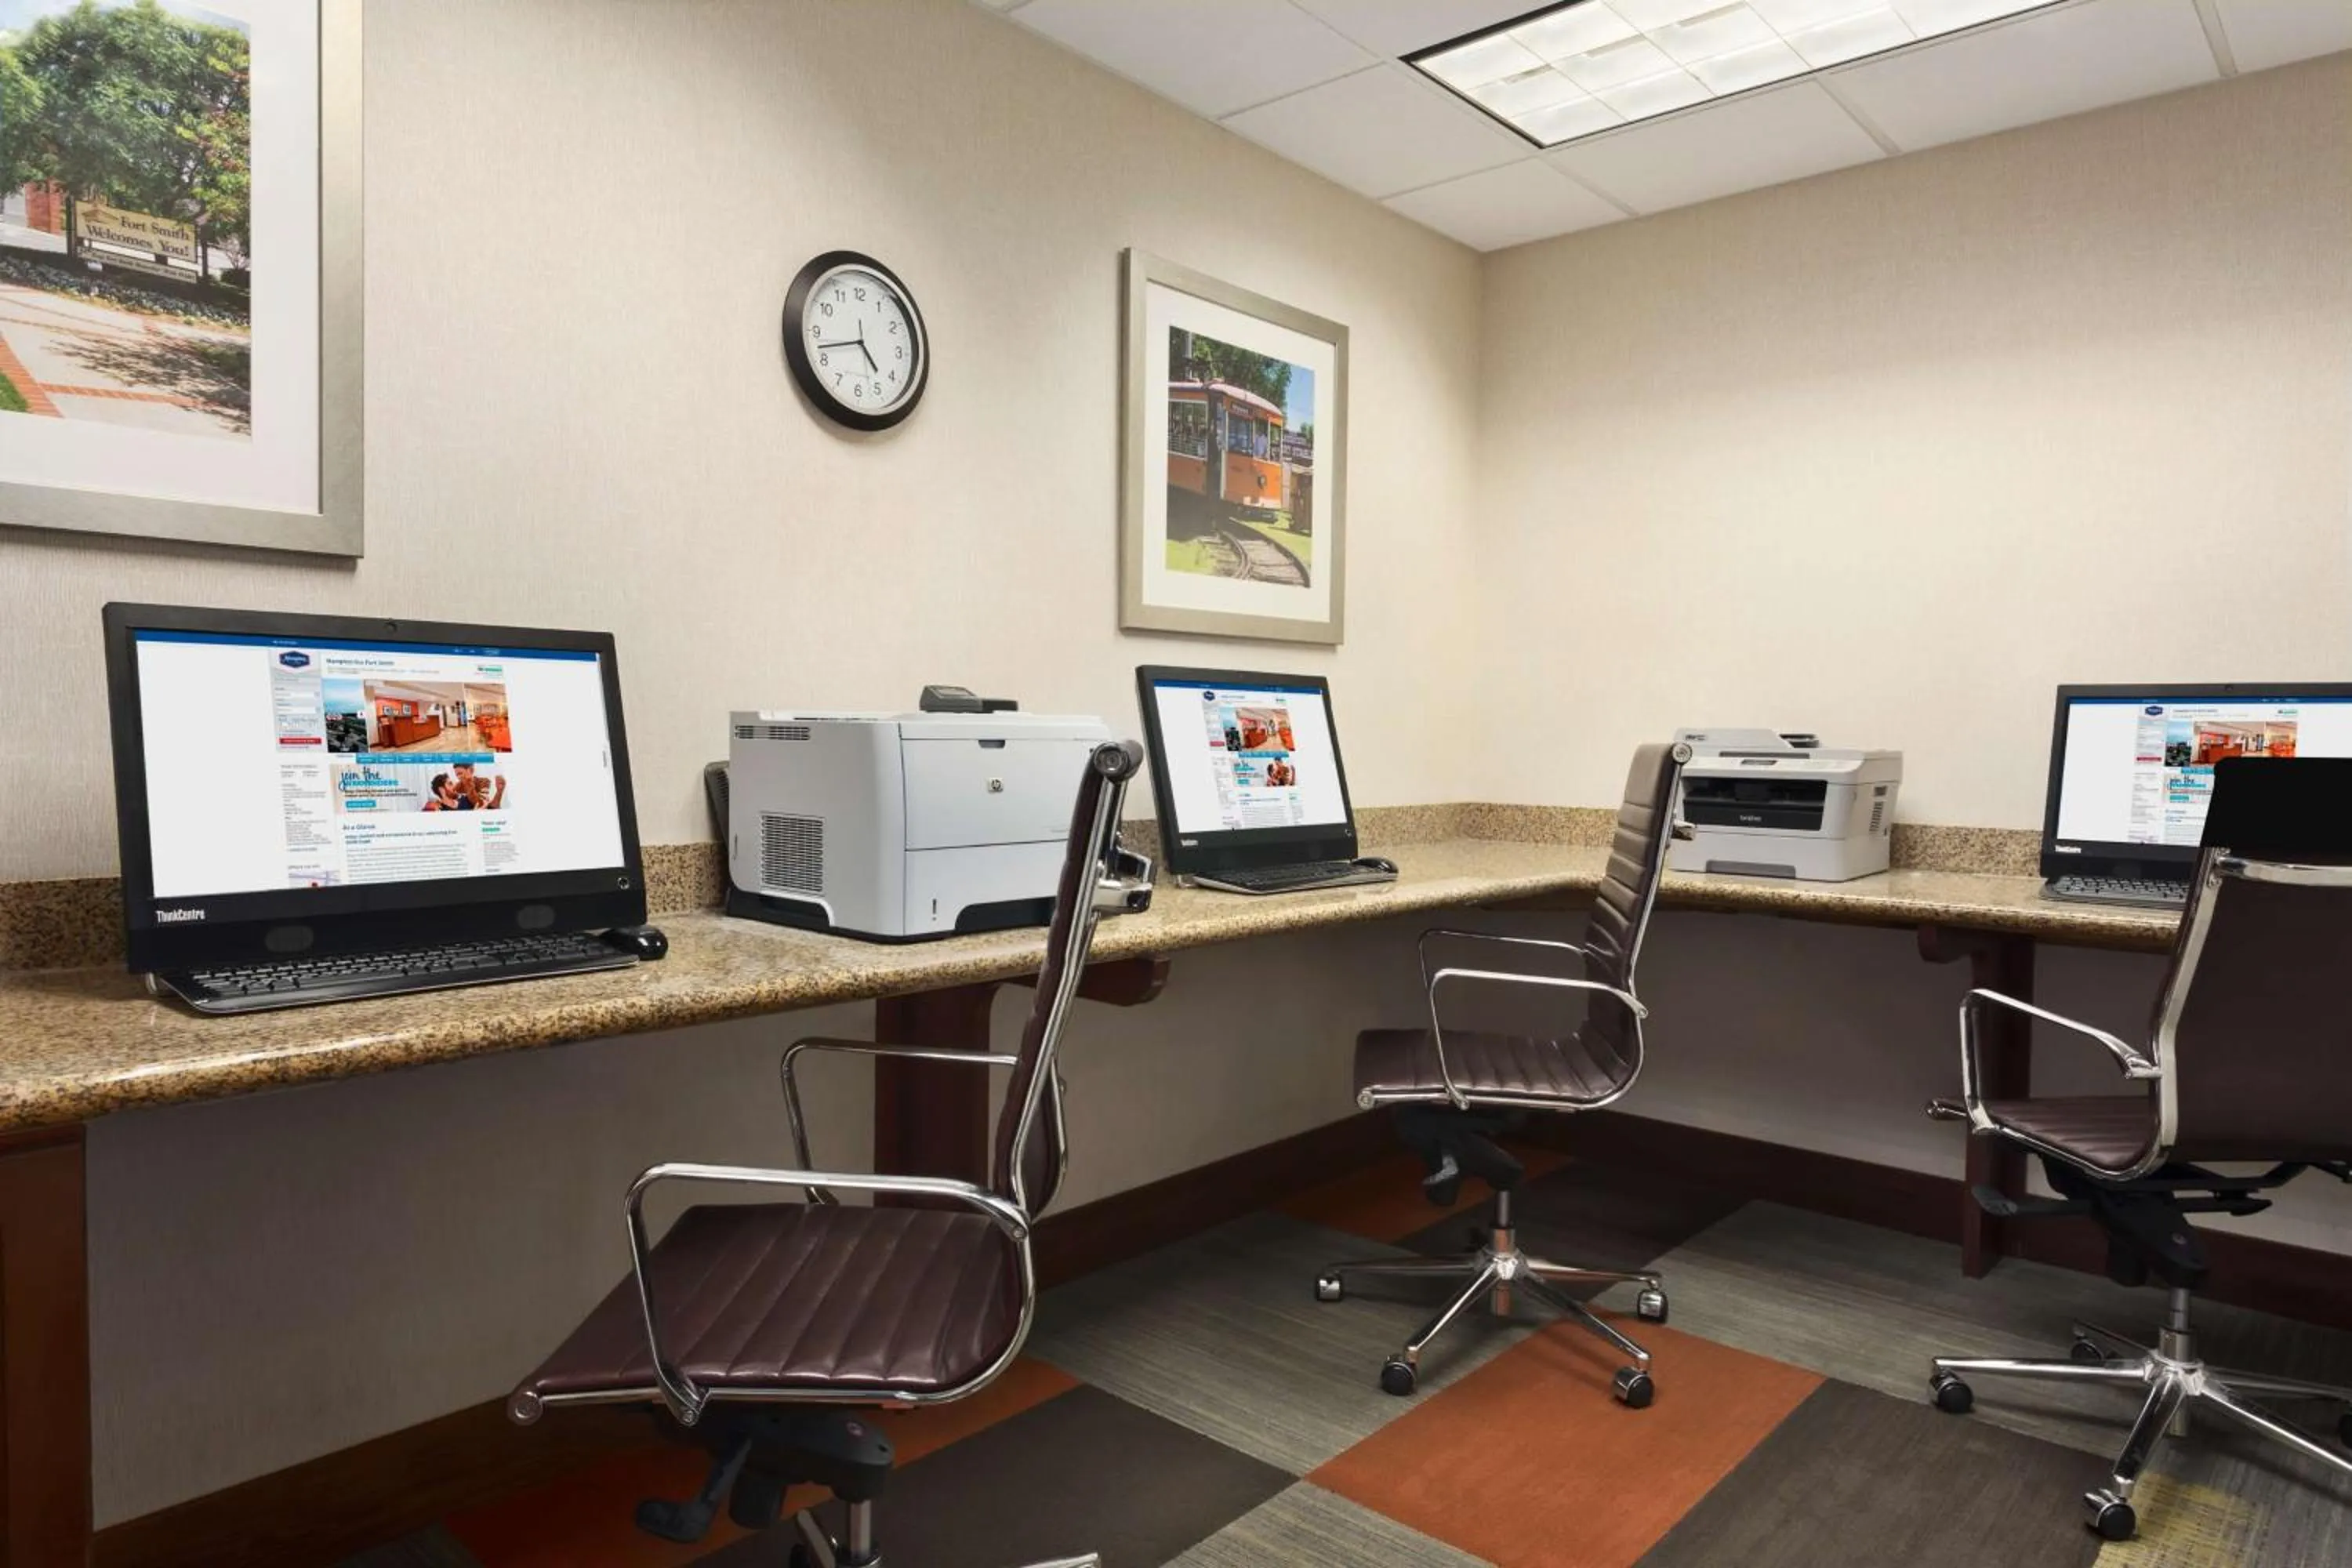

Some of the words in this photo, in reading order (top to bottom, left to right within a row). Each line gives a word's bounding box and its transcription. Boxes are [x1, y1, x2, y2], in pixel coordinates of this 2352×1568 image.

[121, 216, 147, 232] Fort
[151, 222, 190, 241] Smith
[85, 224, 154, 249] Welcomes
[158, 239, 190, 257] You!
[834, 289, 846, 303] 11
[854, 288, 866, 302] 12
[820, 302, 833, 318] 10
[876, 301, 882, 313] 1
[812, 325, 822, 338] 9
[889, 321, 898, 334] 2
[895, 347, 902, 359] 3
[819, 354, 829, 366] 8
[834, 373, 844, 386] 7
[887, 370, 895, 382] 4
[854, 384, 862, 397] 6
[873, 382, 882, 395] 5
